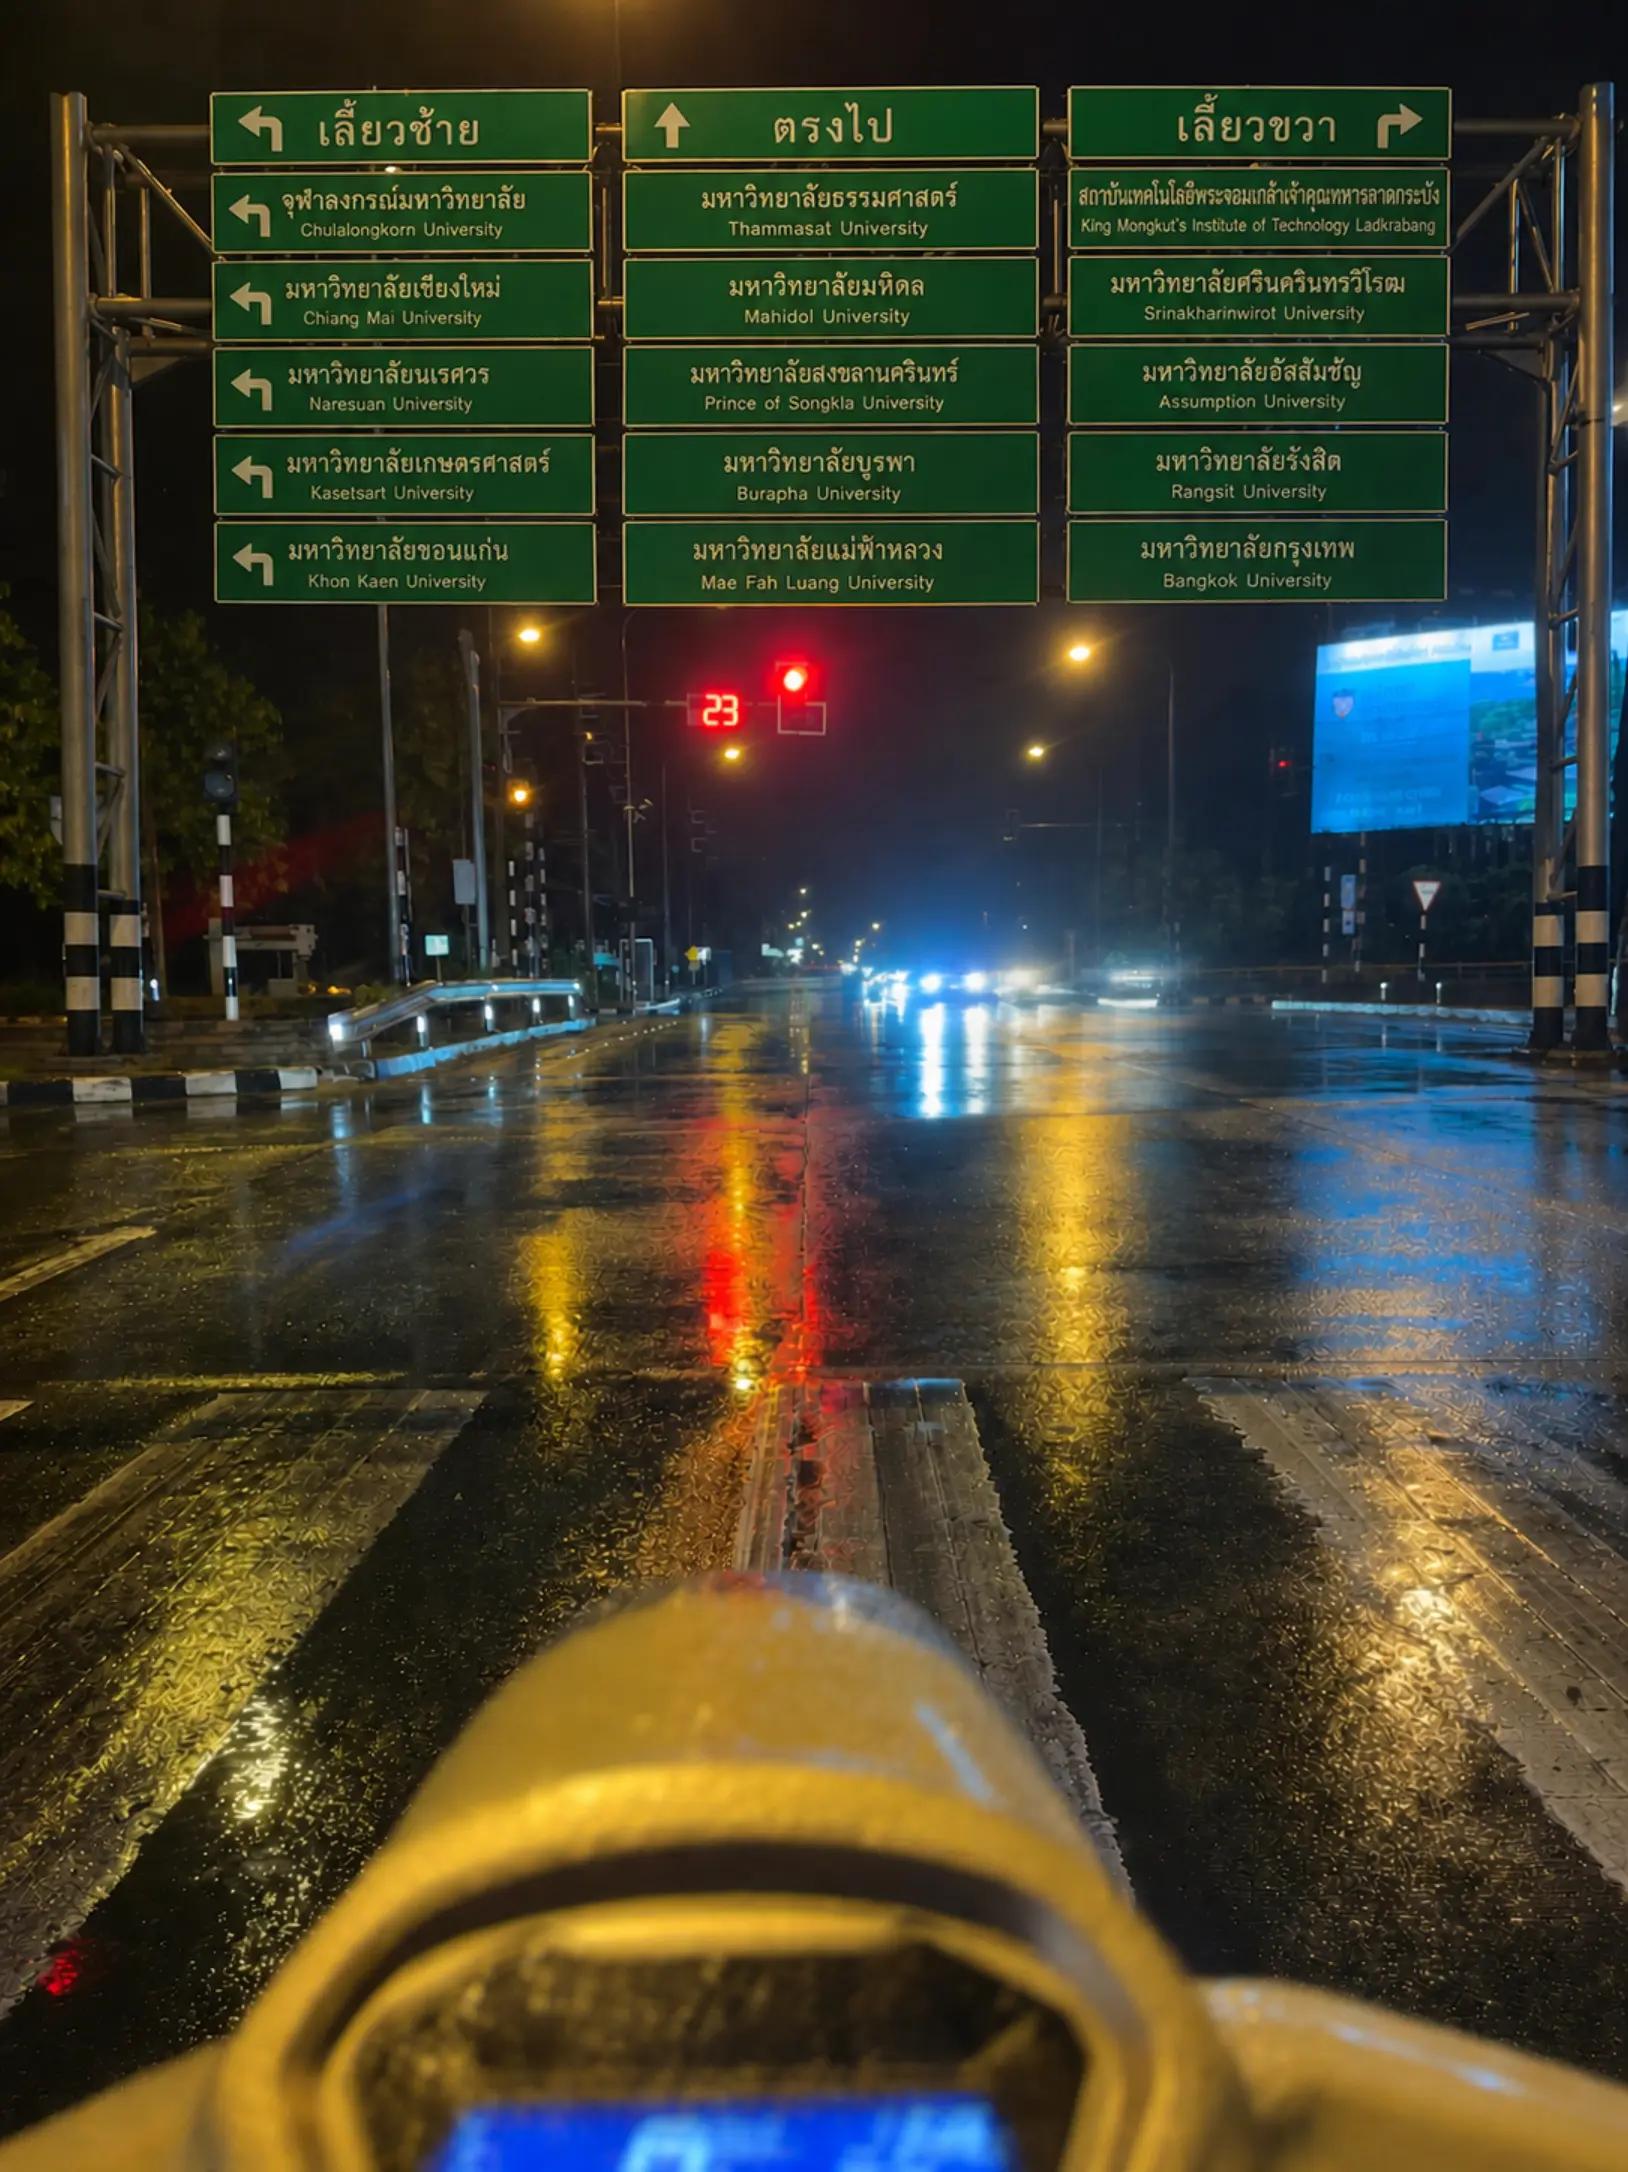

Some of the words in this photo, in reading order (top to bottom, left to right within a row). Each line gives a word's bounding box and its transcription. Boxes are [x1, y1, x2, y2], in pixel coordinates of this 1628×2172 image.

[774, 101, 893, 144] ตรงไป
[1178, 93, 1335, 143] เลี้ยวขวา
[281, 184, 526, 219] จุฬาลงกรณ์มหาวิทยาลัย
[701, 181, 958, 209] มหาวิทยาลัยธรรมศาสตร์
[300, 222, 416, 241] Chulalongkorn
[423, 221, 503, 240] University
[727, 220, 832, 237] Thammasat
[840, 220, 929, 240] University
[1080, 218, 1112, 237] King
[1116, 217, 1187, 237] Mongkut's
[1192, 217, 1247, 233] Institute
[1252, 217, 1267, 233] of
[1271, 217, 1350, 237] Technology
[1355, 217, 1436, 237] Ladkrabang
[285, 272, 501, 300] มหาวิทยาลัยเชียงใหม่
[729, 271, 924, 297] มหาวิทยาลัยมหิดล
[303, 310, 359, 330] Chiang
[366, 310, 395, 325] Mai
[402, 309, 482, 329] University
[744, 308, 814, 324] Mahidol
[822, 307, 910, 327] University
[1144, 305, 1277, 321] Srinakharinwirot
[1284, 305, 1365, 324] University
[288, 359, 490, 385] มหาวิทยาลัยนเรศวร
[1142, 356, 1362, 388] มหาวิทยาลัยอัสสัมชัญ
[309, 396, 386, 412] Naresuan
[392, 396, 473, 415] University
[704, 395, 757, 411] Prince
[764, 395, 781, 411] of
[788, 395, 855, 414] Songkla
[862, 395, 944, 414] University
[1158, 394, 1256, 413] Assumption
[1264, 393, 1346, 412] University
[287, 447, 551, 474] มหาวิทยาลัยเกษตรศาสตร์
[723, 446, 915, 480] มหาวิทยาลัยบูรพา
[1156, 445, 1341, 472] มหาวิทยาลัยรังสิต
[311, 485, 386, 501] Kasetsart
[394, 485, 474, 503] University
[737, 485, 808, 505] Burapha
[817, 485, 901, 505] University
[1171, 483, 1235, 503] Rangsit
[1243, 483, 1327, 502] University
[288, 535, 509, 561] มหาวิทยาลัยขอนแก่น
[693, 534, 943, 561] มหาวิทยาลัยแม่ฟ้าหลวง
[1140, 532, 1355, 568] มหาวิทยาลัยกรุงเทพ
[308, 573, 350, 589] Khon
[357, 574, 399, 589] Kaen
[406, 573, 486, 592] University
[701, 574, 737, 591] Mae
[745, 574, 778, 590] Fah
[786, 575, 840, 594] Luang
[848, 574, 935, 593] University
[1163, 572, 1238, 592] Bangkok
[1246, 572, 1332, 591] University
[702, 693, 739, 727] 23
